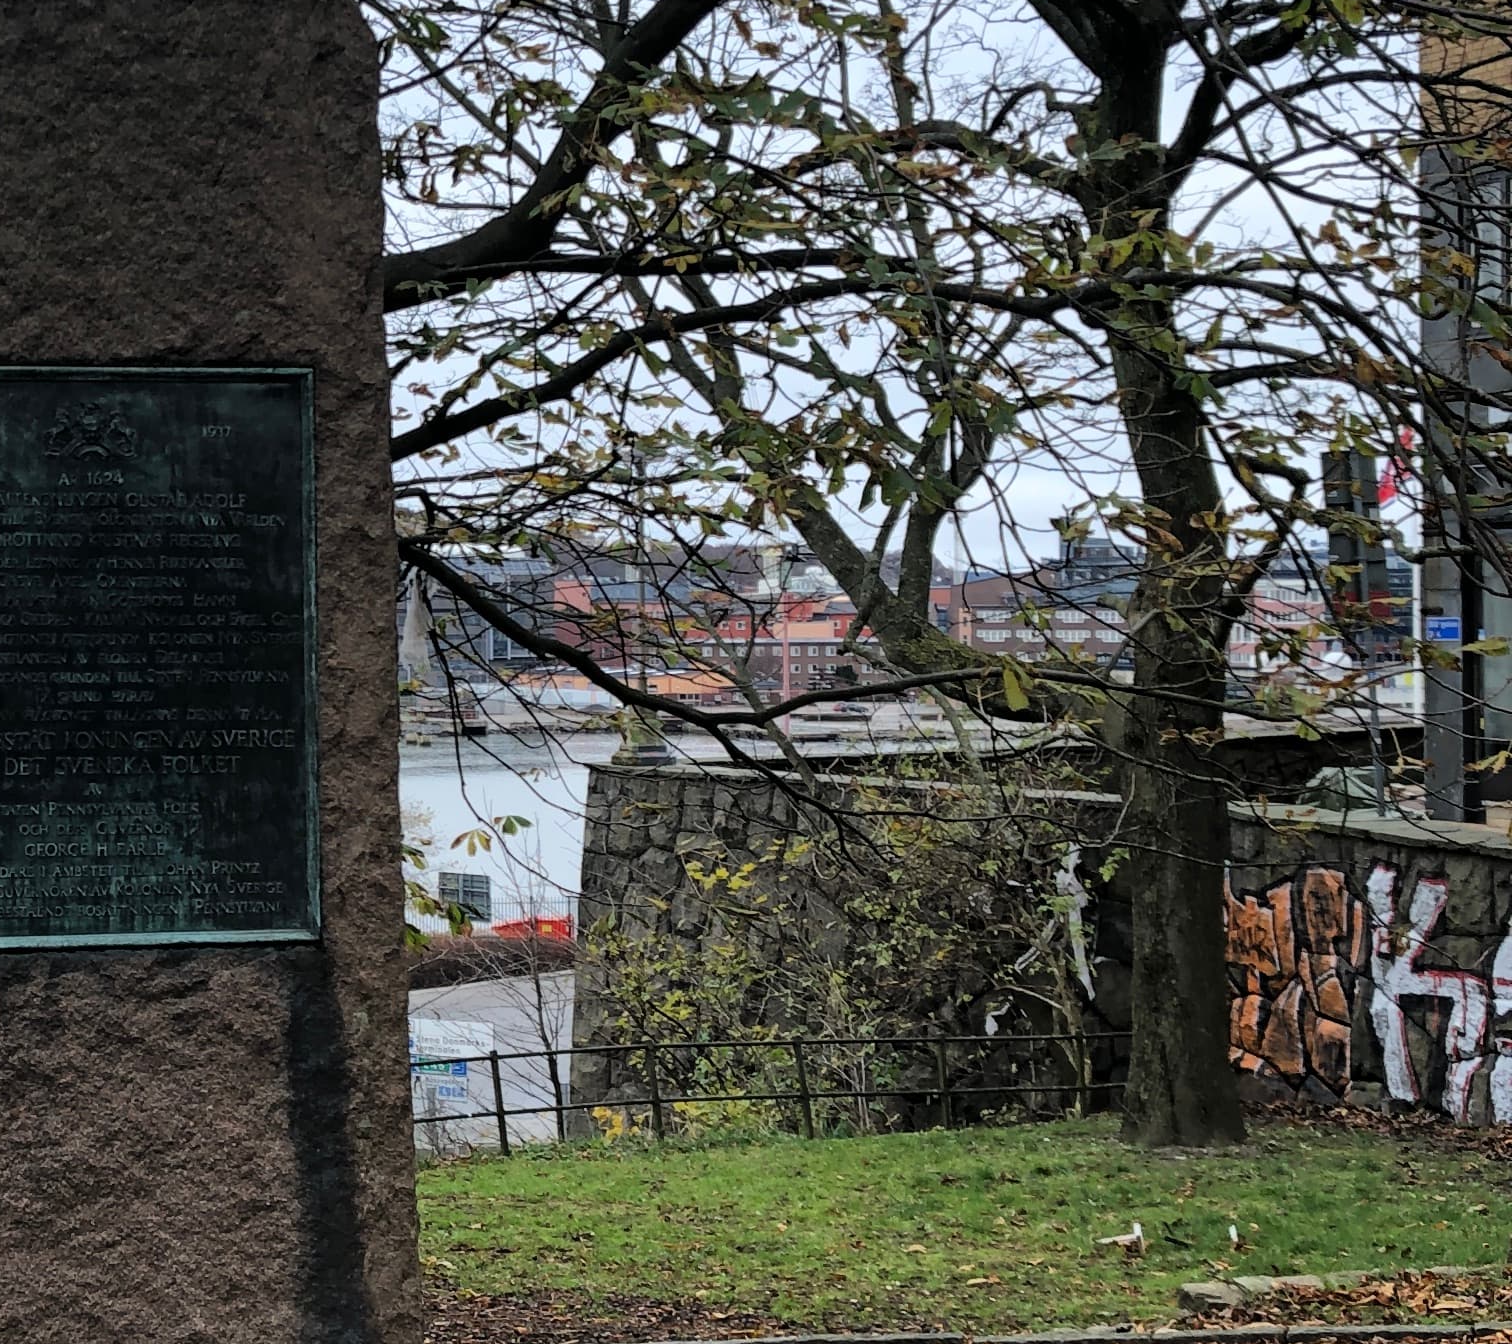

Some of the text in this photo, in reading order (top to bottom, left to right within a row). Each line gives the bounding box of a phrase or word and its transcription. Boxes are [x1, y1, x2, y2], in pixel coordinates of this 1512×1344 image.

[201, 424, 233, 438] 1937
[86, 471, 125, 486] 1624
[192, 493, 249, 508] ADOLF
[63, 730, 173, 750] KONUNGEN
[176, 731, 207, 750] AV
[210, 729, 296, 750] SVERIGE
[4, 756, 47, 776] DET
[54, 756, 154, 776] SVENSKA
[160, 755, 240, 775] FOLKET
[18, 824, 49, 836] OCH
[24, 842, 89, 857] GEORGE
[96, 842, 108, 857] H
[211, 859, 262, 875] PRINTZ
[190, 880, 219, 895] NYA
